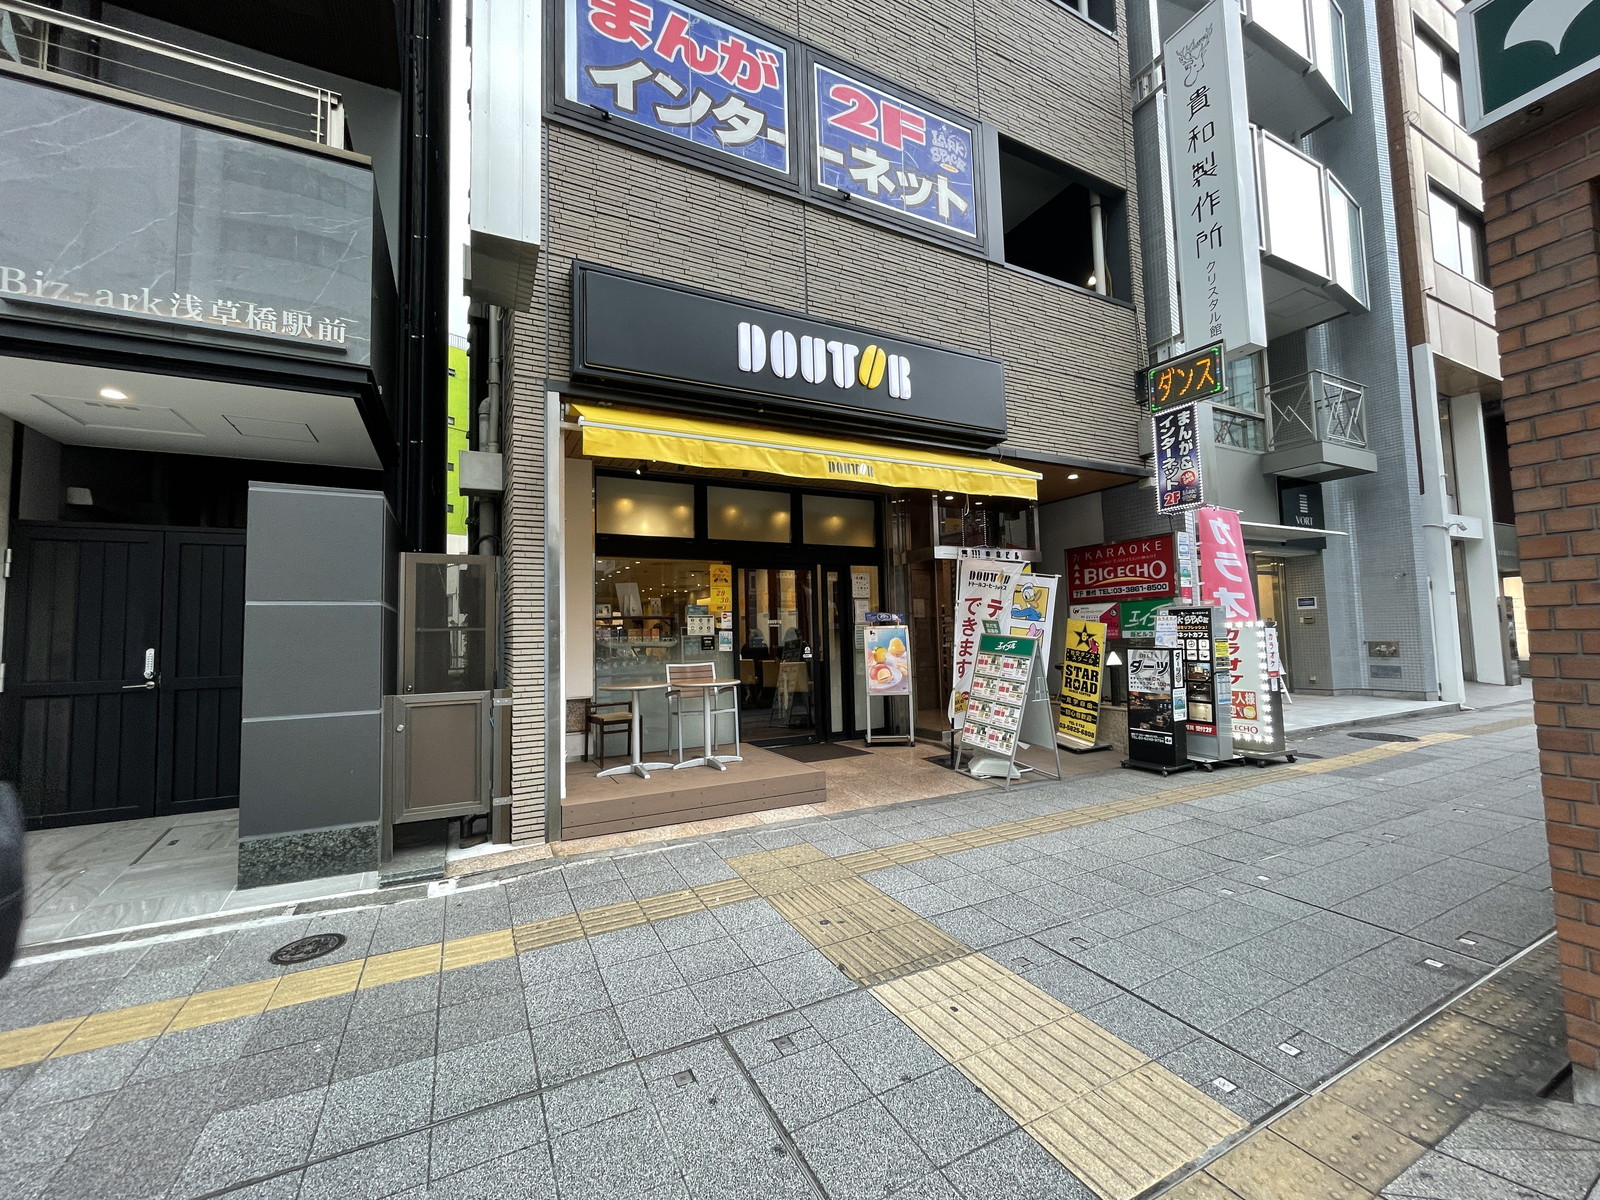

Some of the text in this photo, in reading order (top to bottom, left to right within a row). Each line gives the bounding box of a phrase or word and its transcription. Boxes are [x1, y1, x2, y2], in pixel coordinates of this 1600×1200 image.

[587, 0, 779, 92] まんが
[827, 84, 926, 149] 2F
[1186, 85, 1222, 258] 貴和製作所
[1206, 261, 1222, 338] クリスタル館
[738, 321, 912, 400] DOUTOR
[1158, 358, 1214, 402] ダンス
[1159, 415, 1179, 491] インターネット
[828, 461, 873, 478] DOUTOR
[1164, 491, 1180, 506] 2F
[1295, 515, 1313, 526] VORT
[1085, 540, 1162, 561] KARAOKE
[969, 571, 1011, 584] DOUTOR
[956, 597, 983, 679] できます
[1065, 664, 1099, 683] STAR
[1130, 660, 1169, 675] ダーツ
[1064, 676, 1098, 695] ROAD
[1234, 724, 1258, 734] ECHO
